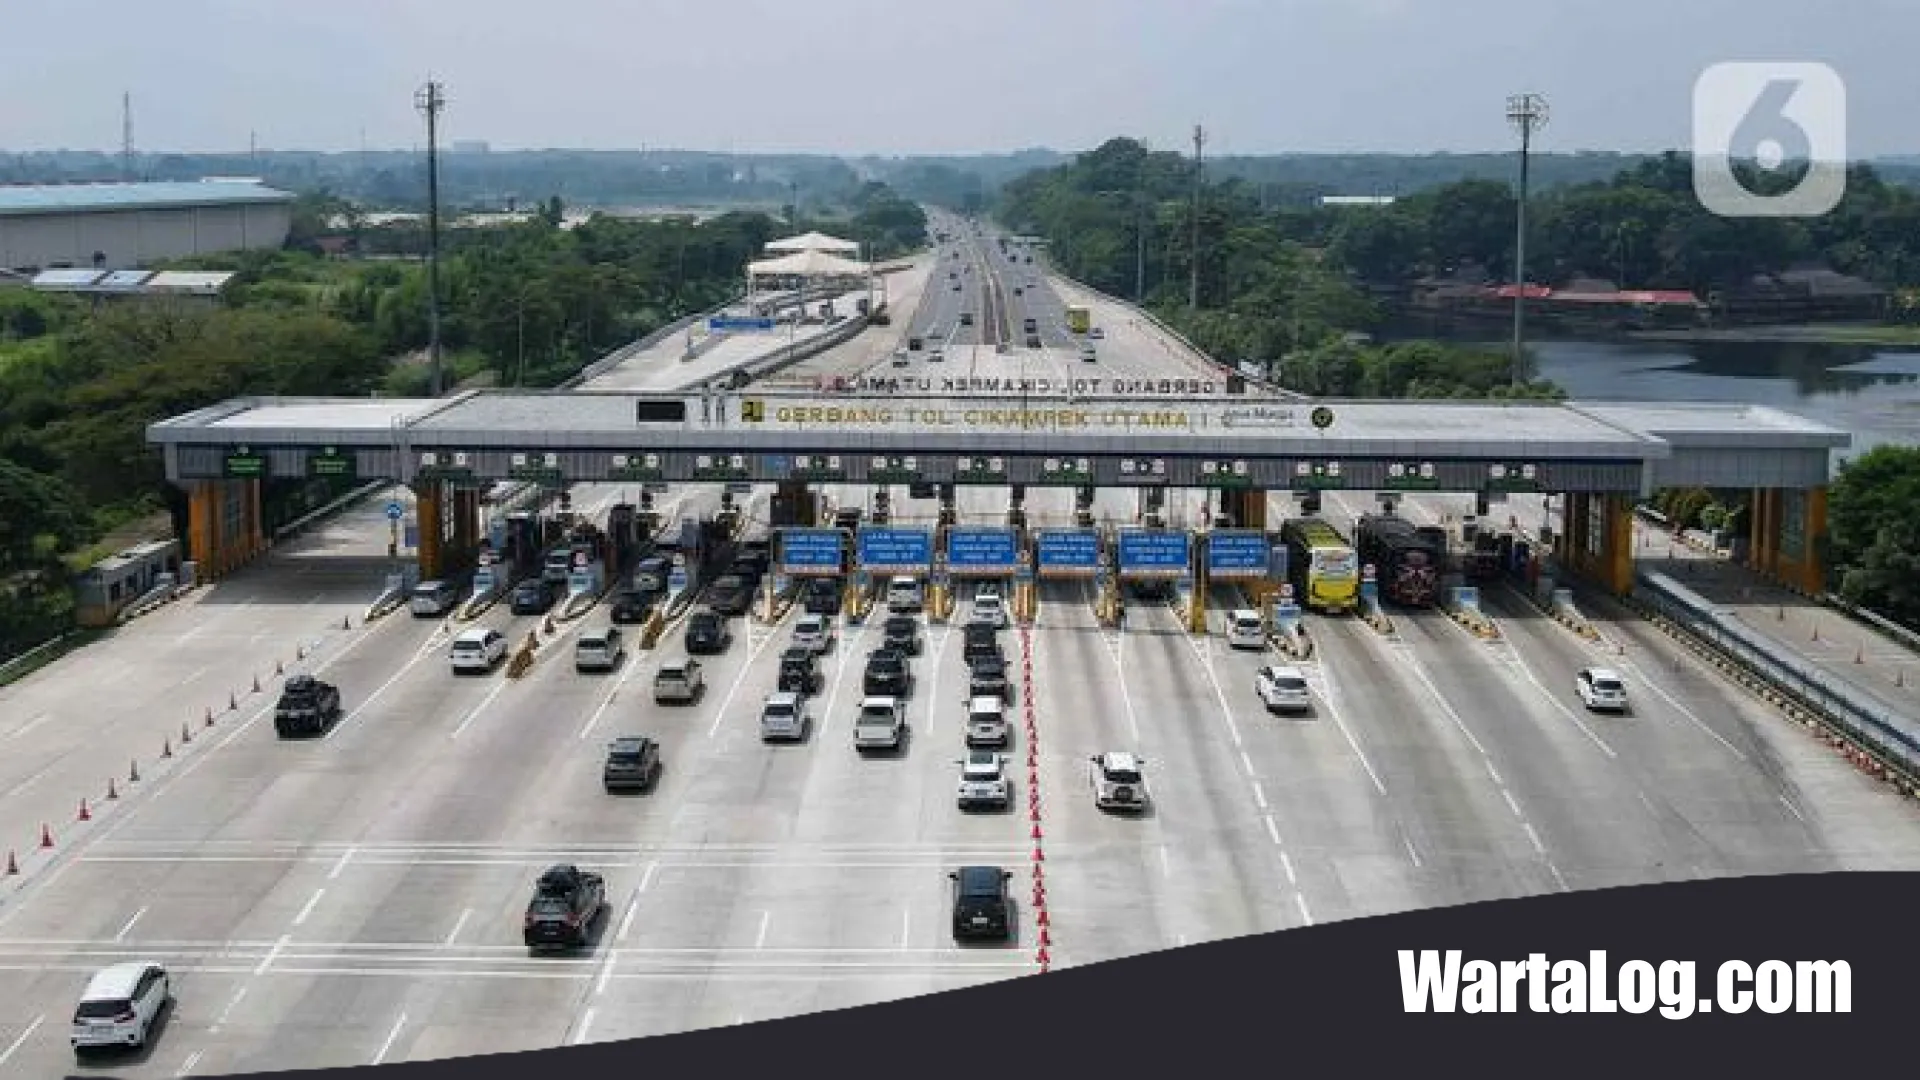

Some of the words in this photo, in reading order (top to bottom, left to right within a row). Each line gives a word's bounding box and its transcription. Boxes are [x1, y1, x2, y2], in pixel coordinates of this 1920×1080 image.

[775, 406, 893, 424] GERBANG
[907, 408, 954, 425] TOL
[1103, 409, 1188, 428] UTAMA
